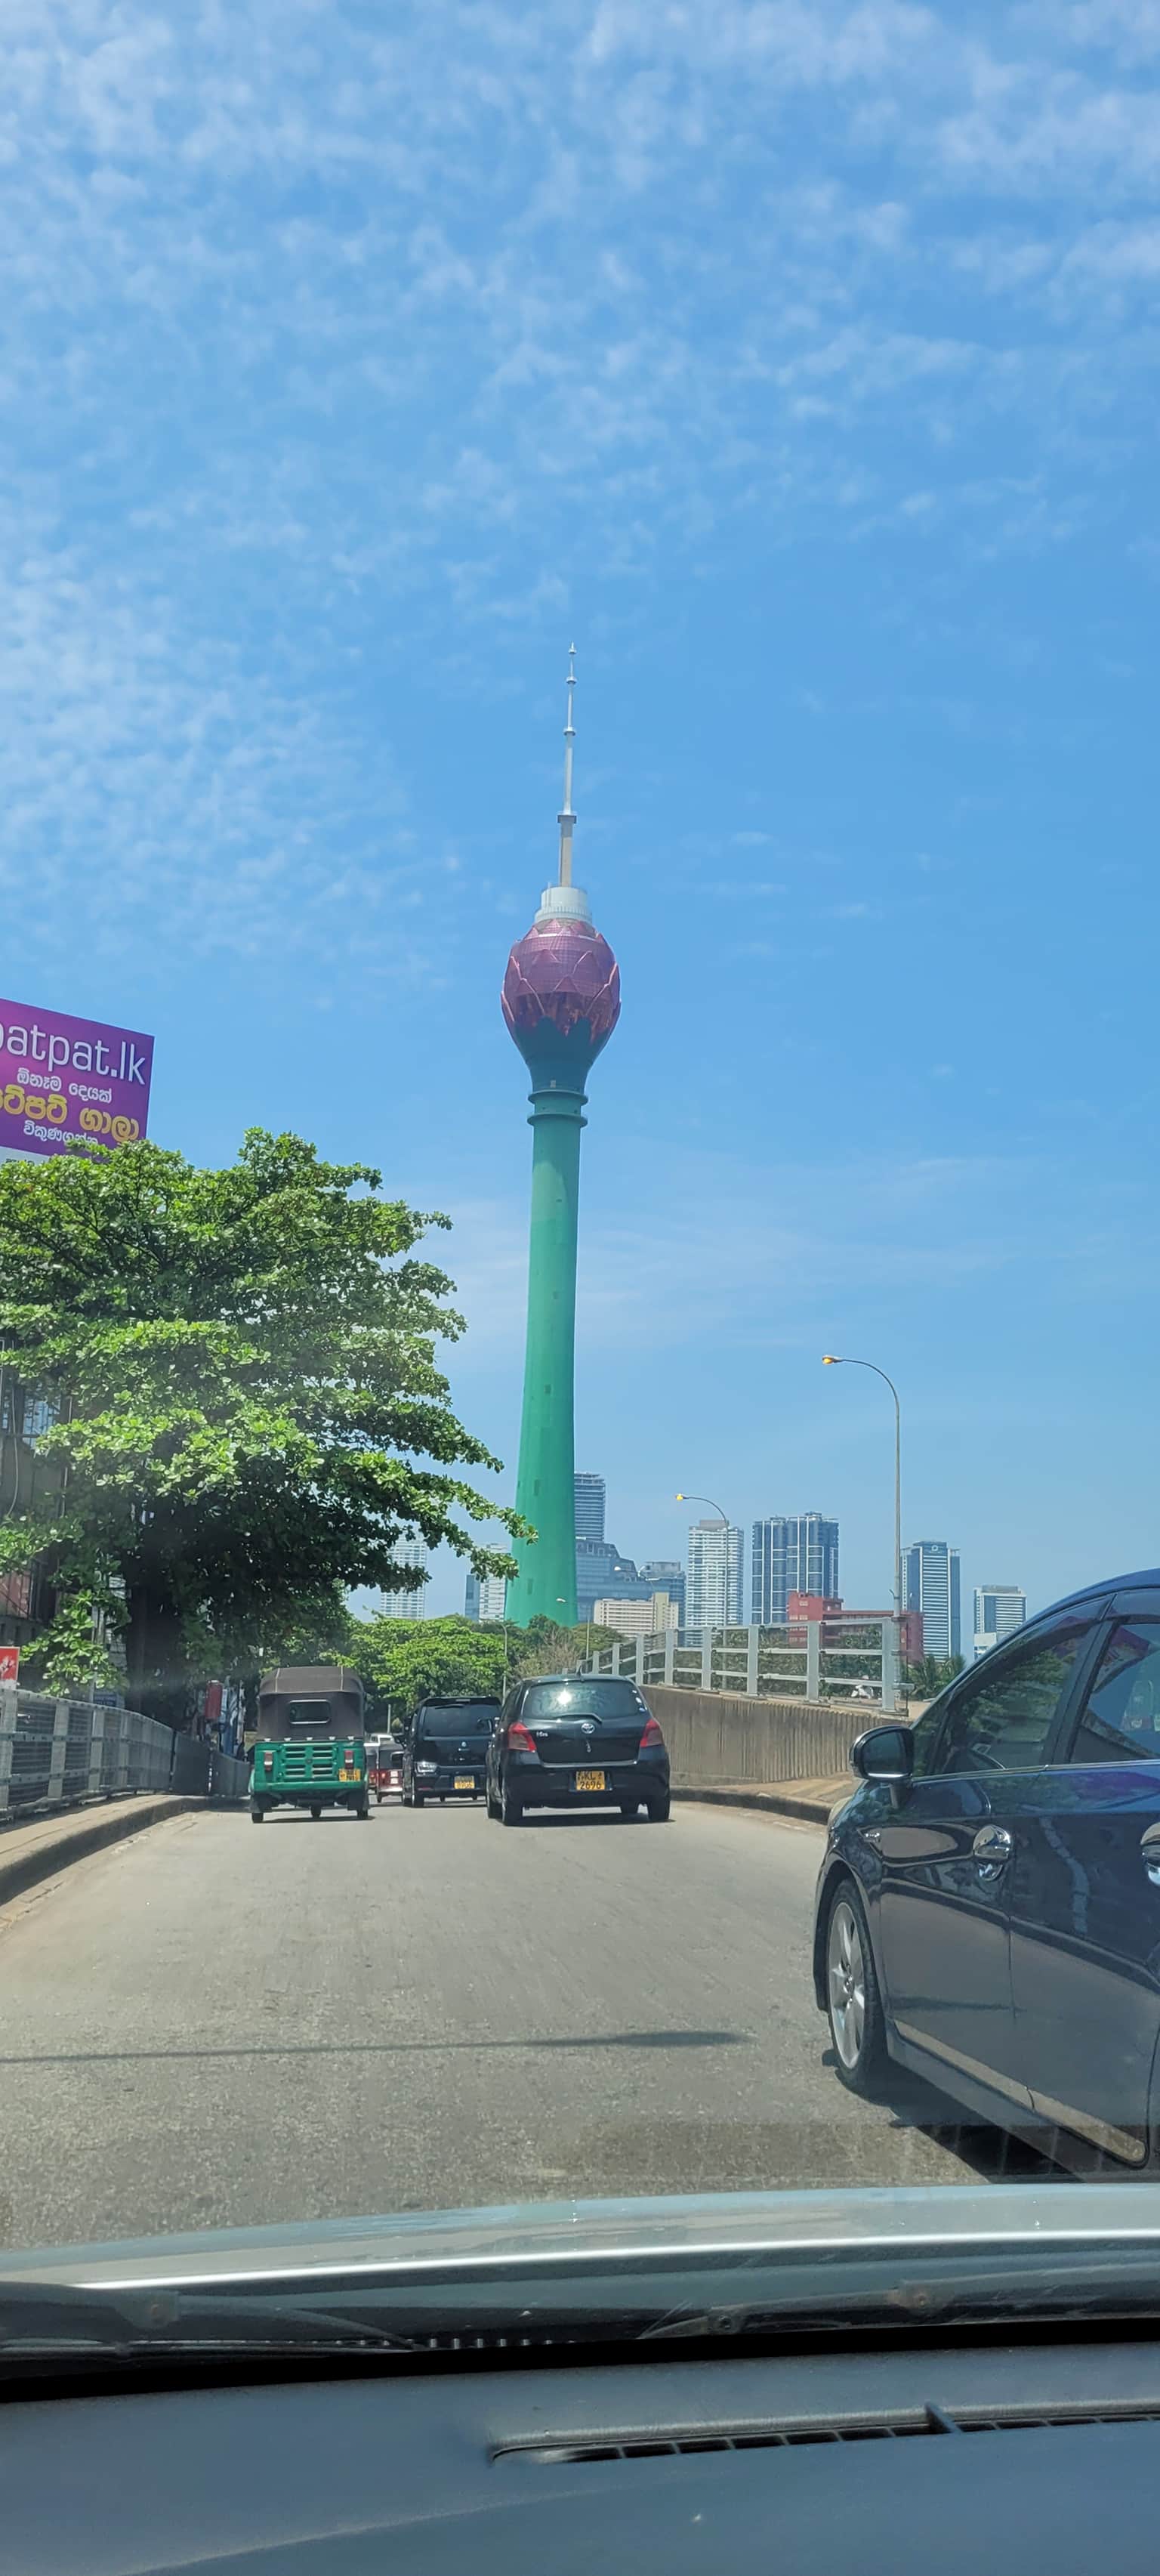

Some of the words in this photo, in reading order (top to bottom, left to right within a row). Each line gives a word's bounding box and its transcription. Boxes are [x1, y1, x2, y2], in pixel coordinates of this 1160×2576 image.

[0, 1023, 146, 1085] atpat.lk
[0, 1084, 67, 1123] ට්පට්
[580, 1781, 601, 1790] 2696
